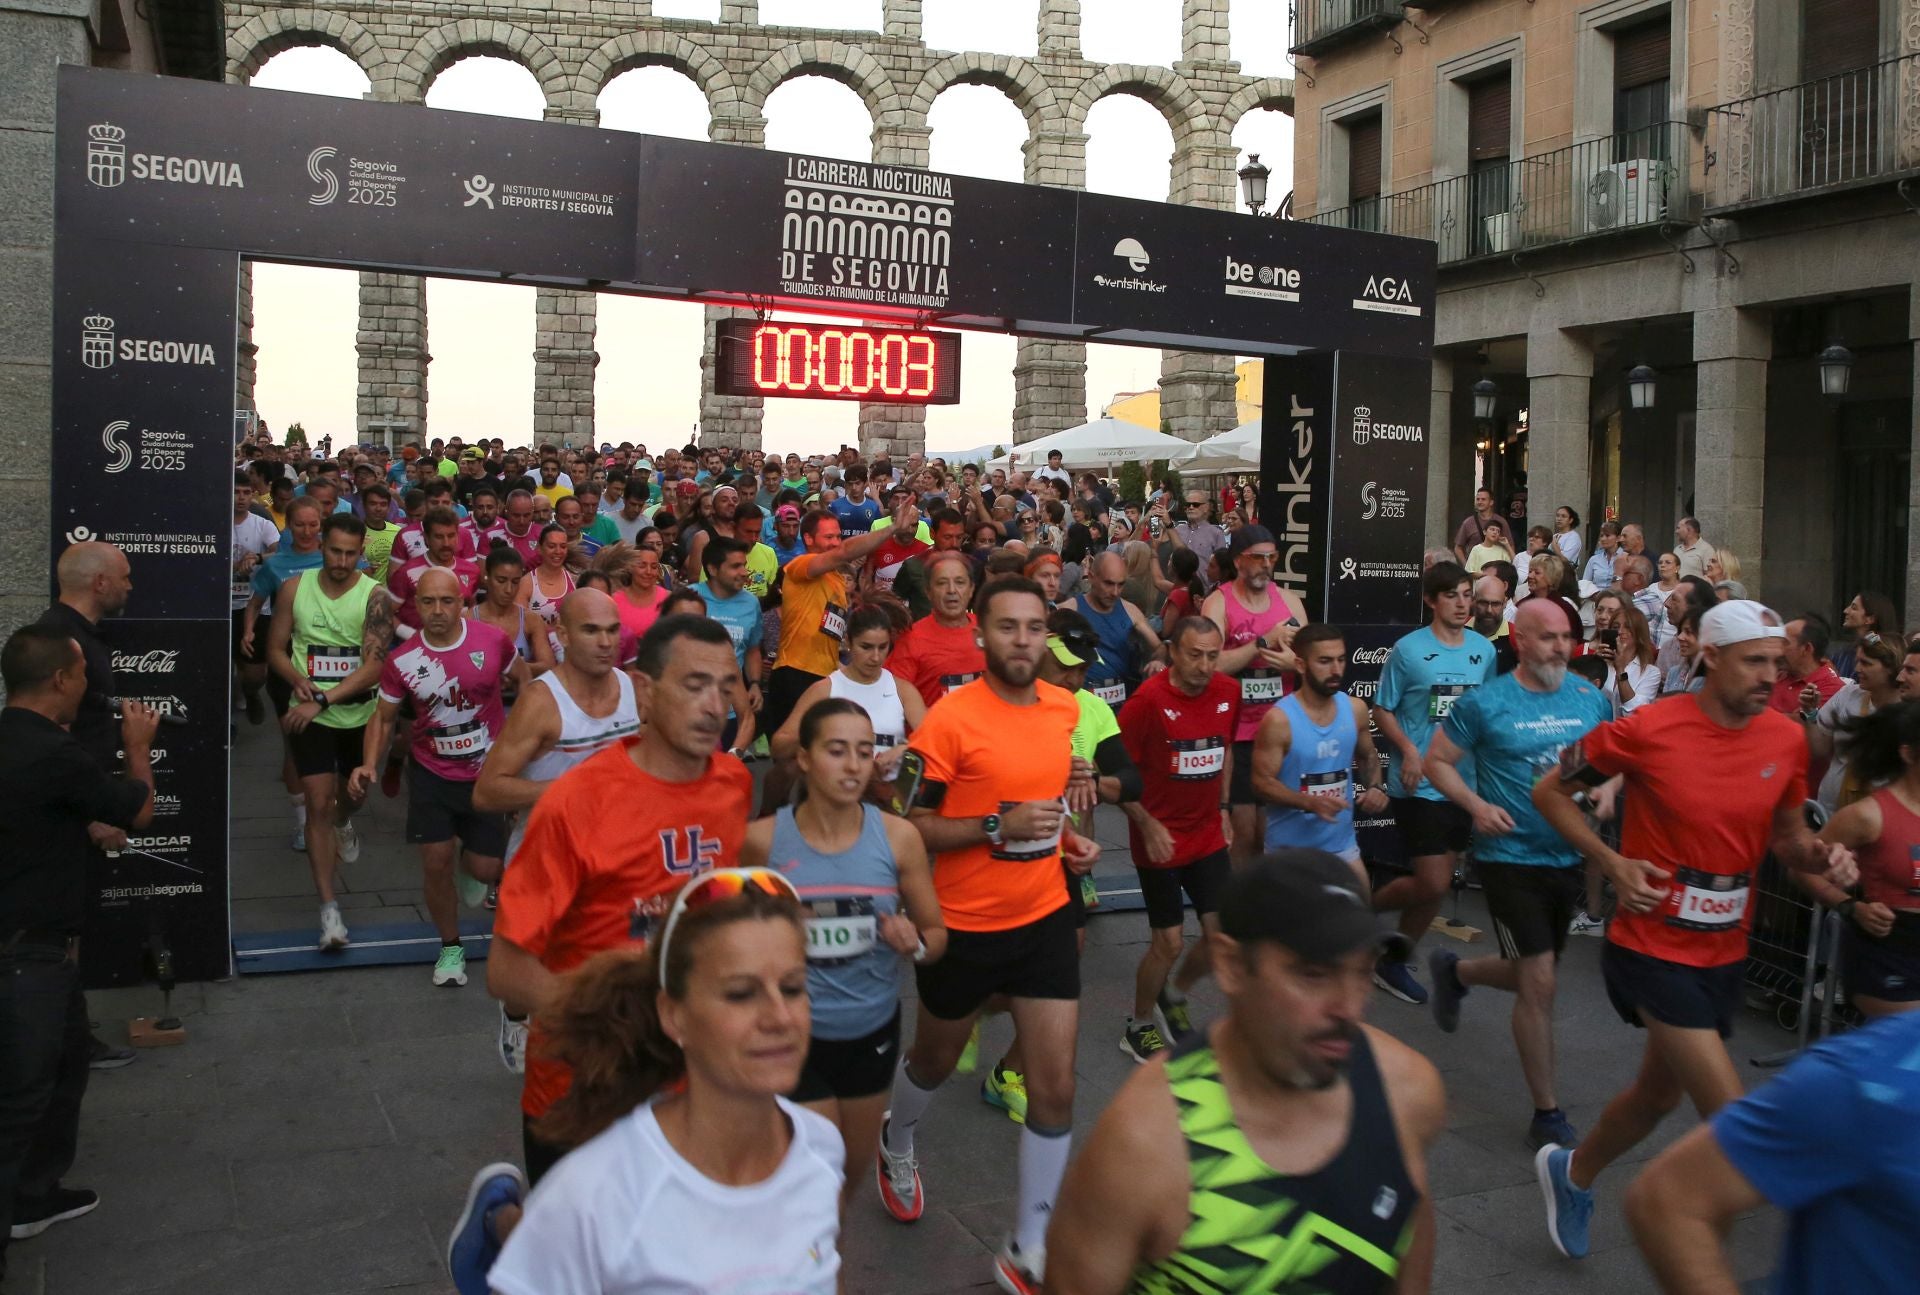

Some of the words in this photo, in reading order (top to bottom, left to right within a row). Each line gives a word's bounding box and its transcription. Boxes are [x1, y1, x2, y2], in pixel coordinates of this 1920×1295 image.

[132, 152, 244, 189] SEGOVIA
[350, 157, 397, 172] Segovia
[350, 170, 375, 179] Ciudad
[376, 172, 406, 182] Europea
[787, 157, 793, 177] I
[797, 158, 868, 187] CARRERA
[872, 168, 953, 198] NOCTURNA
[349, 179, 361, 187] del
[363, 180, 397, 190] Deporte
[348, 187, 397, 207] 2025
[503, 184, 550, 198] INSTITUTO
[552, 188, 599, 203] MUNICIPAL
[602, 194, 614, 204] DE
[502, 195, 558, 211] DEPORTES
[567, 202, 614, 216] SEGOVIA
[782, 251, 815, 282] DE
[831, 256, 949, 296] SEGOVIA
[1225, 255, 1254, 283] be
[1094, 274, 1168, 293] eventsthinker
[1362, 274, 1413, 303] AGA
[825, 285, 874, 301] PATRIMONIO
[875, 290, 885, 302] DE
[887, 291, 897, 303] LA
[119, 338, 215, 366] SEGOVIA
[754, 326, 935, 397] 00:00:03
[141, 428, 186, 441] Segovia
[1372, 423, 1423, 442] SEGOVIA
[141, 440, 165, 448] Ciudad
[166, 441, 194, 449] Europea
[154, 448, 185, 456] Deporte
[140, 455, 186, 471] 2025
[1381, 487, 1406, 497] Segovia
[1381, 506, 1405, 518] 2025
[105, 533, 152, 542] INSTITUTO
[154, 533, 202, 543] MUNICIPAL
[205, 535, 216, 543] DE
[113, 543, 160, 553] PORTES
[170, 544, 217, 554] SEGOVIA
[1360, 569, 1390, 578] DEPORTES
[1394, 570, 1420, 578] SEGOVIA
[317, 661, 349, 671] 1110
[1244, 682, 1274, 693] 5074
[440, 737, 472, 750] 1180
[1183, 755, 1214, 768] 1034
[808, 925, 850, 946] 110
